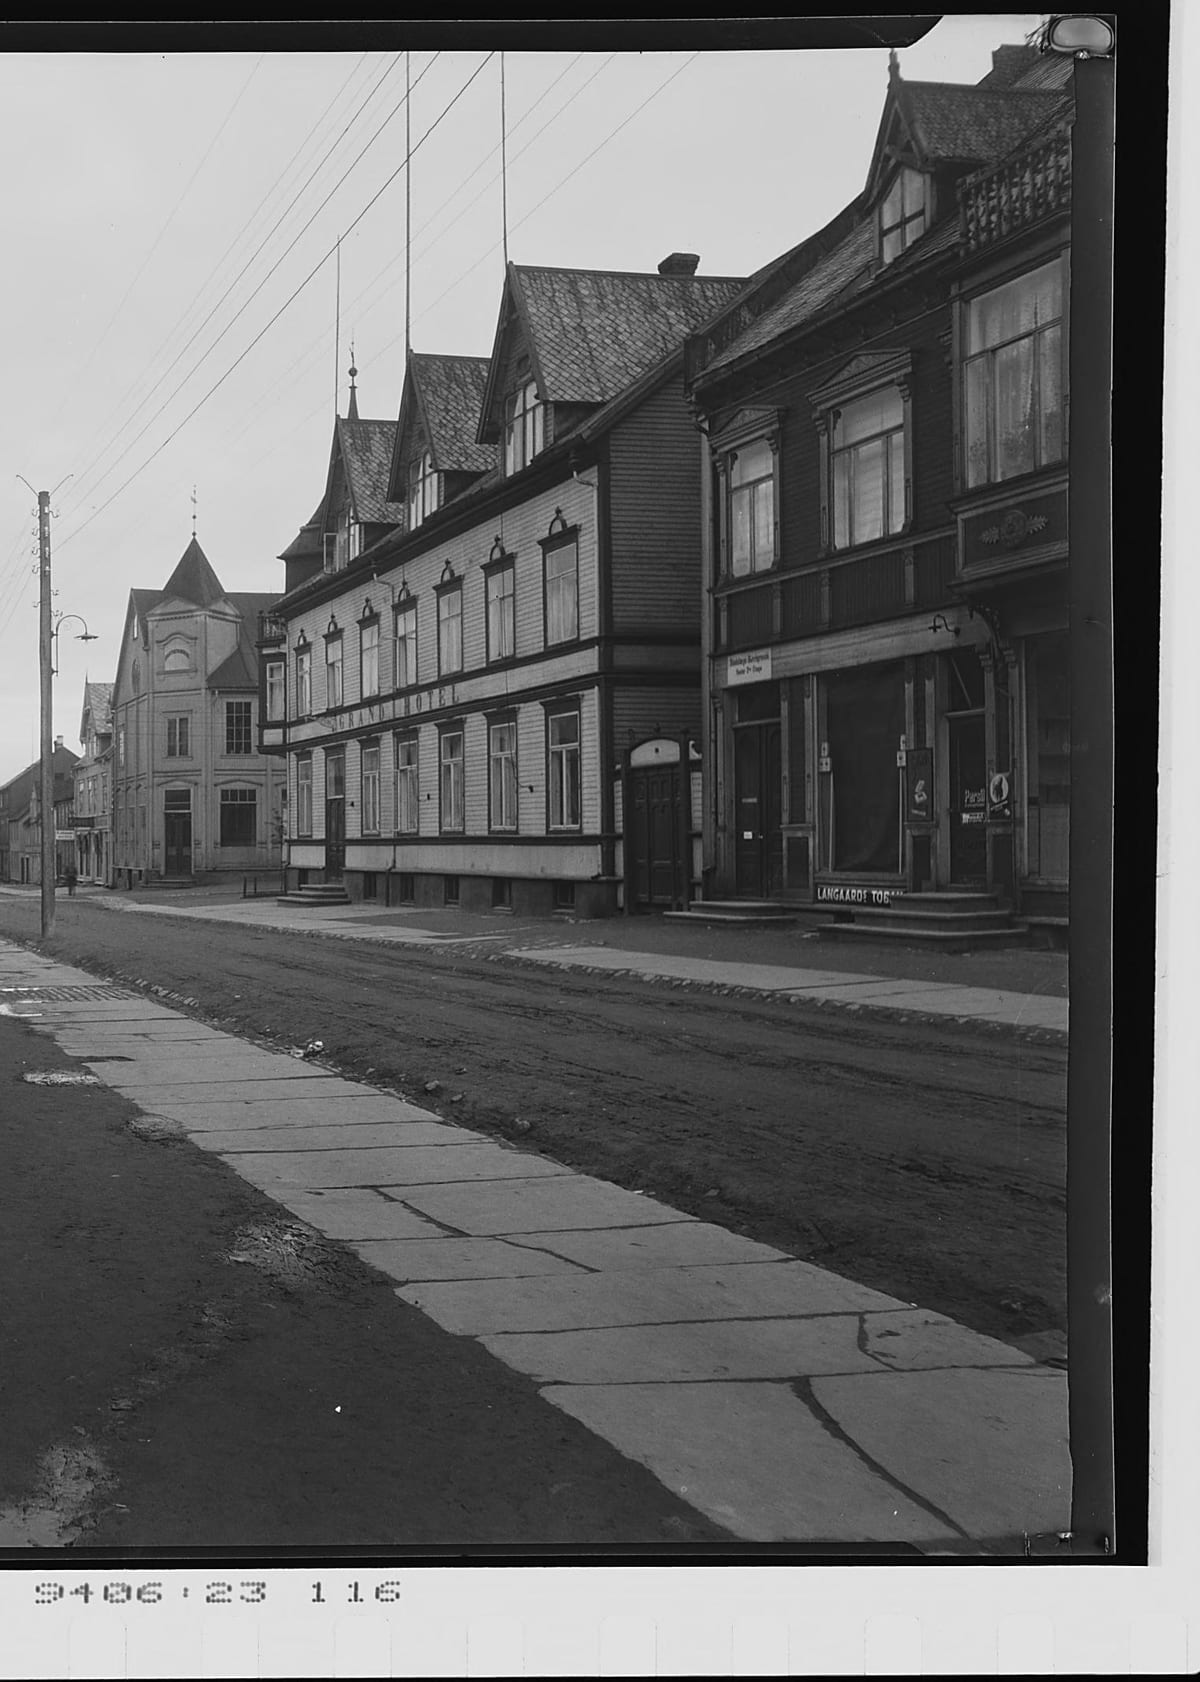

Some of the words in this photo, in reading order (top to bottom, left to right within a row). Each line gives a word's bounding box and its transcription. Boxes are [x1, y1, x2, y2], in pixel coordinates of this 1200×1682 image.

[338, 703, 385, 730] GRAND
[404, 684, 460, 716] HOTEL
[872, 890, 904, 904] TOB
